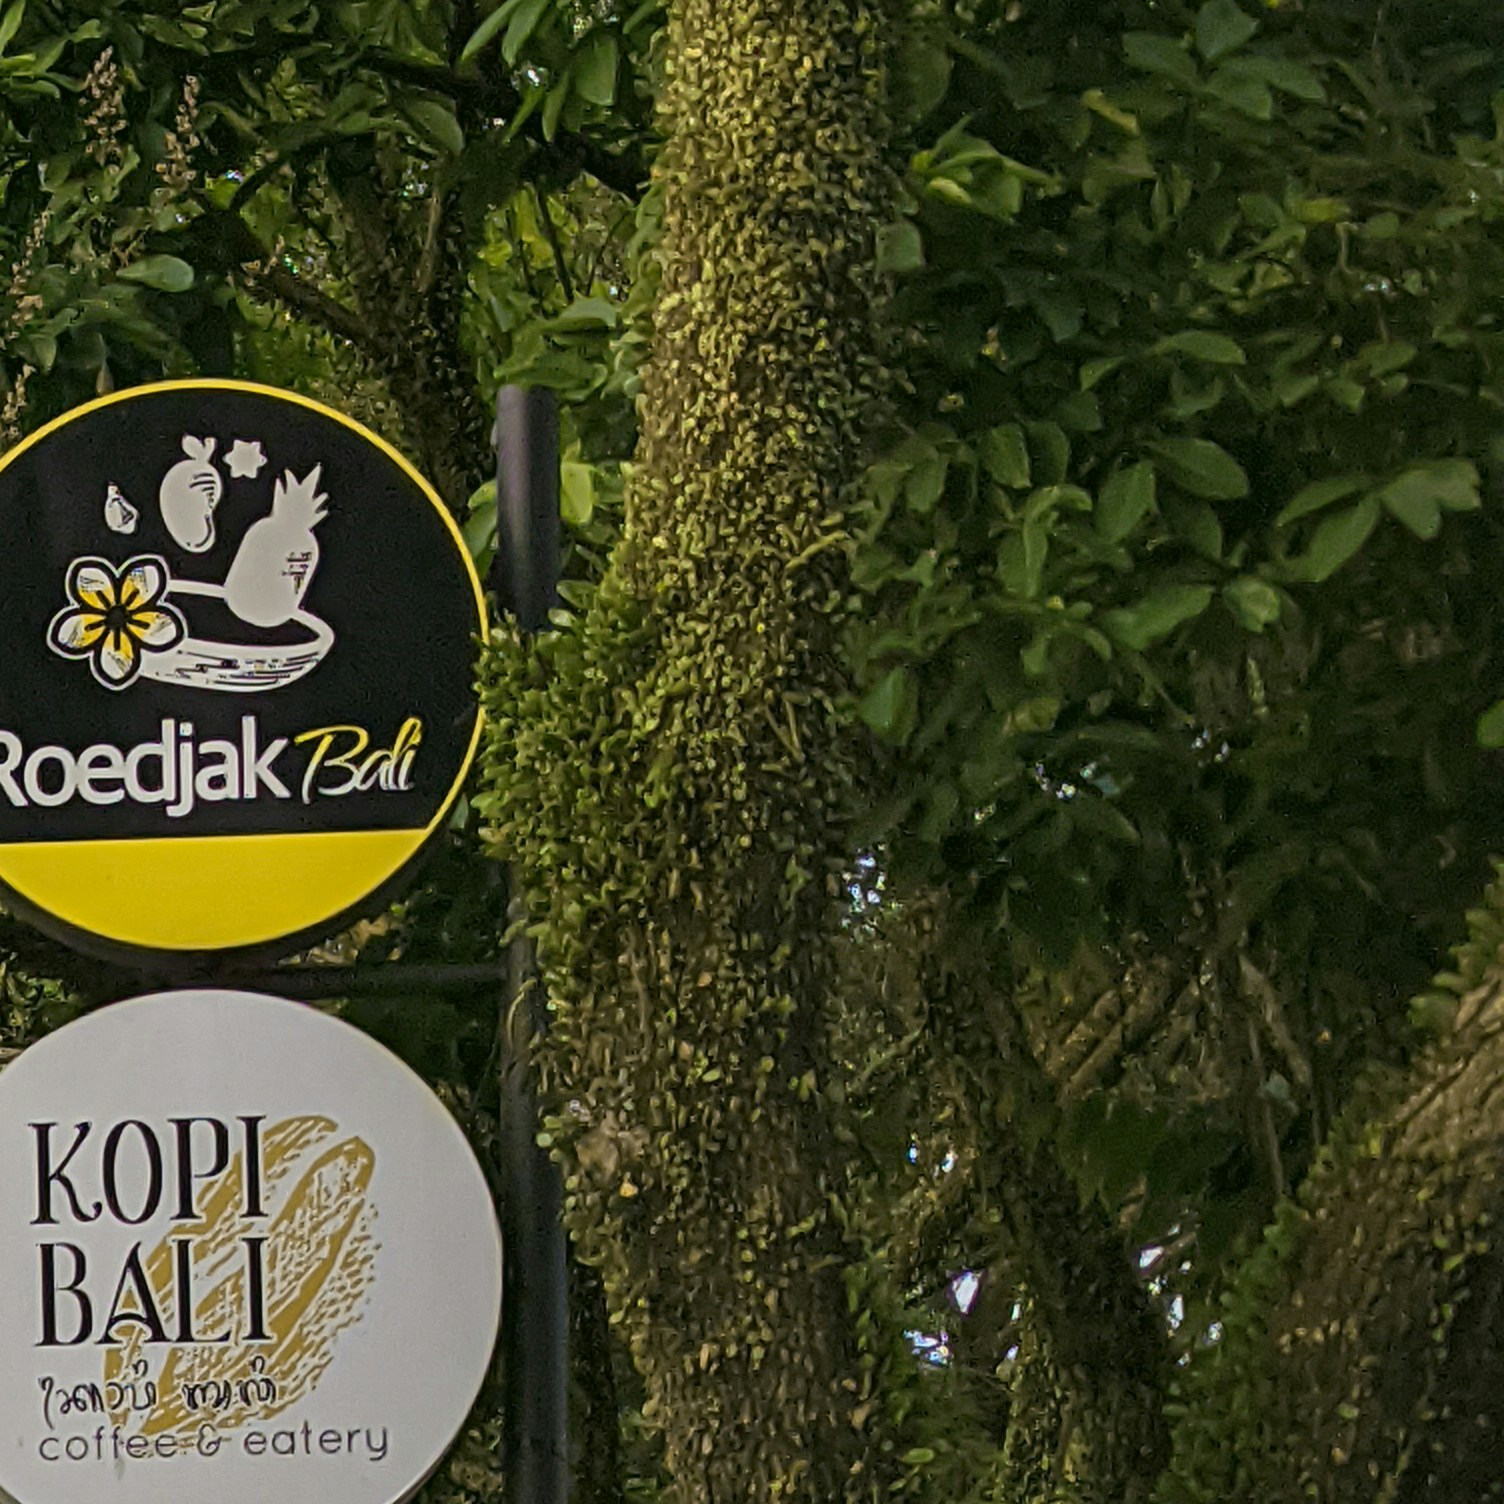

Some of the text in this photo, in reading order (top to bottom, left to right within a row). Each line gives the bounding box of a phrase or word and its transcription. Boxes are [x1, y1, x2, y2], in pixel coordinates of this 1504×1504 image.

[295, 716, 423, 805] Bali
[28, 1114, 269, 1225] KOPI
[34, 1236, 273, 1347] BALI
[39, 1420, 388, 1462] coffee & eatery
